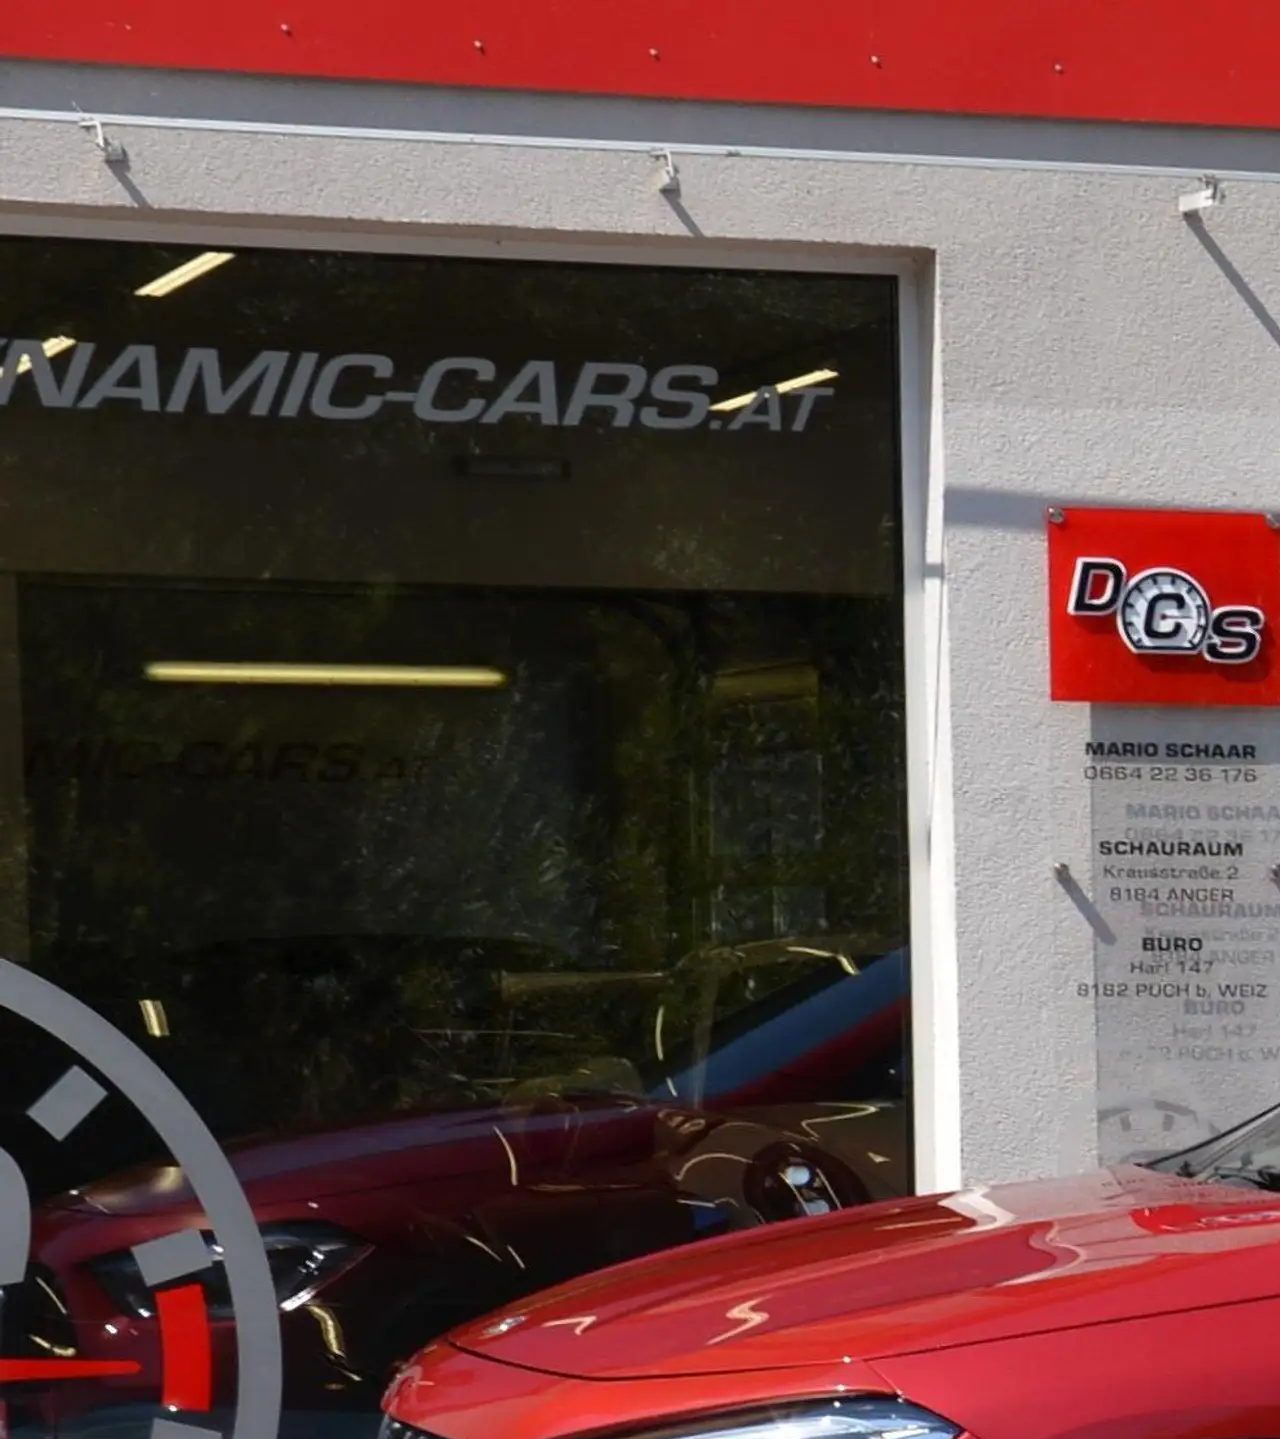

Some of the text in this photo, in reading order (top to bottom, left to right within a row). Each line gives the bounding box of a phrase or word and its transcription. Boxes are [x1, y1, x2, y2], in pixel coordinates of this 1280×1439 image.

[0, 337, 834, 432] NAMIC-CARS.AT
[1085, 742, 1256, 759] MARIO SCHAAR
[1084, 766, 1257, 783] 0664 22 36 176
[1099, 841, 1243, 857] SCHAURAUM
[1226, 866, 1239, 880] 2
[1110, 887, 1234, 902] 8184 ANGER
[1178, 961, 1214, 975] 147
[1077, 983, 1129, 997] 8182
[1136, 983, 1190, 998] PUCH
[1218, 984, 1268, 998] WEIZ
